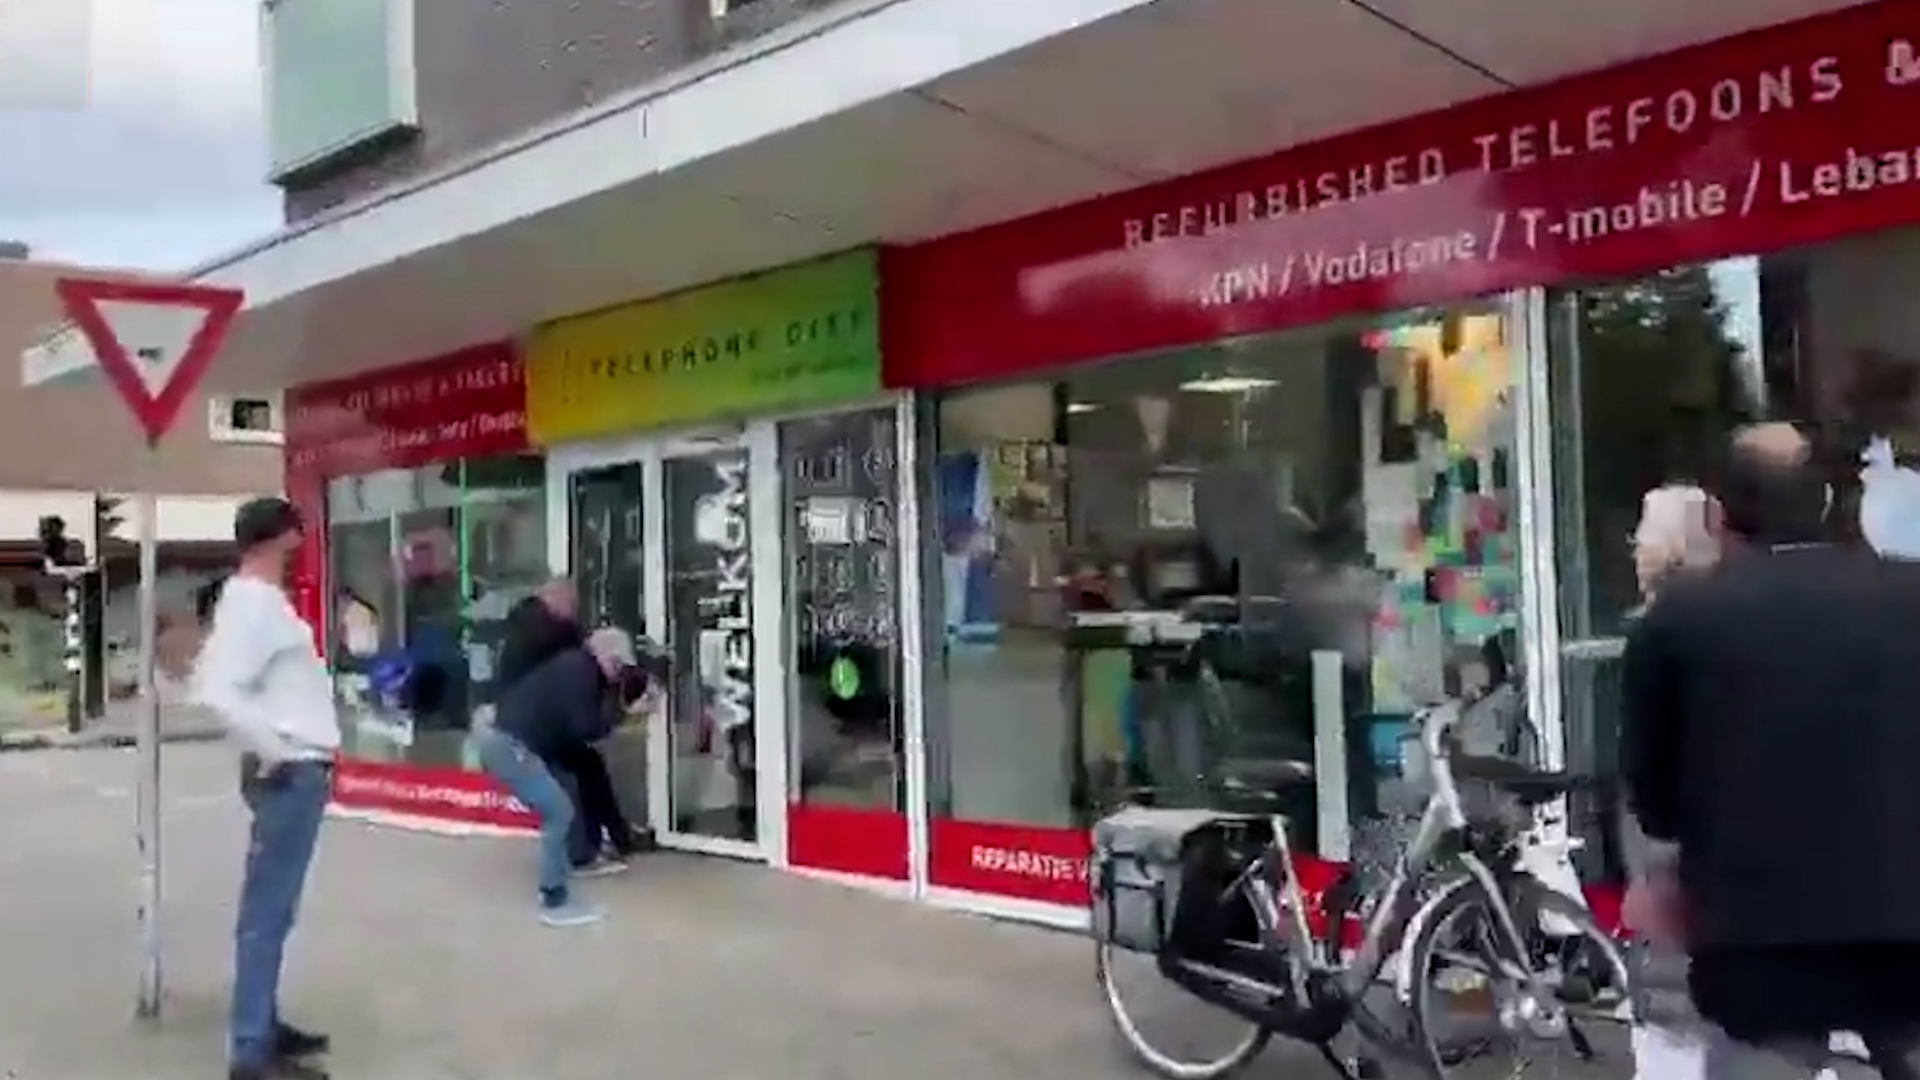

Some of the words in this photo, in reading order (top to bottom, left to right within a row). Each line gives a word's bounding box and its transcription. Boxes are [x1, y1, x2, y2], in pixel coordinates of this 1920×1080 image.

[1124, 149, 1445, 250] REFURBISHED
[1473, 57, 1843, 172] TELEFOONS
[1278, 256, 1295, 296] /
[1304, 231, 1476, 287] Vodafone
[1487, 212, 1505, 262] /
[1519, 180, 1726, 250] T-mobile
[1740, 160, 1760, 217] /
[1780, 146, 1920, 202] Leba
[715, 460, 751, 733] WELKOM
[971, 845, 1073, 880] REPARATIE
